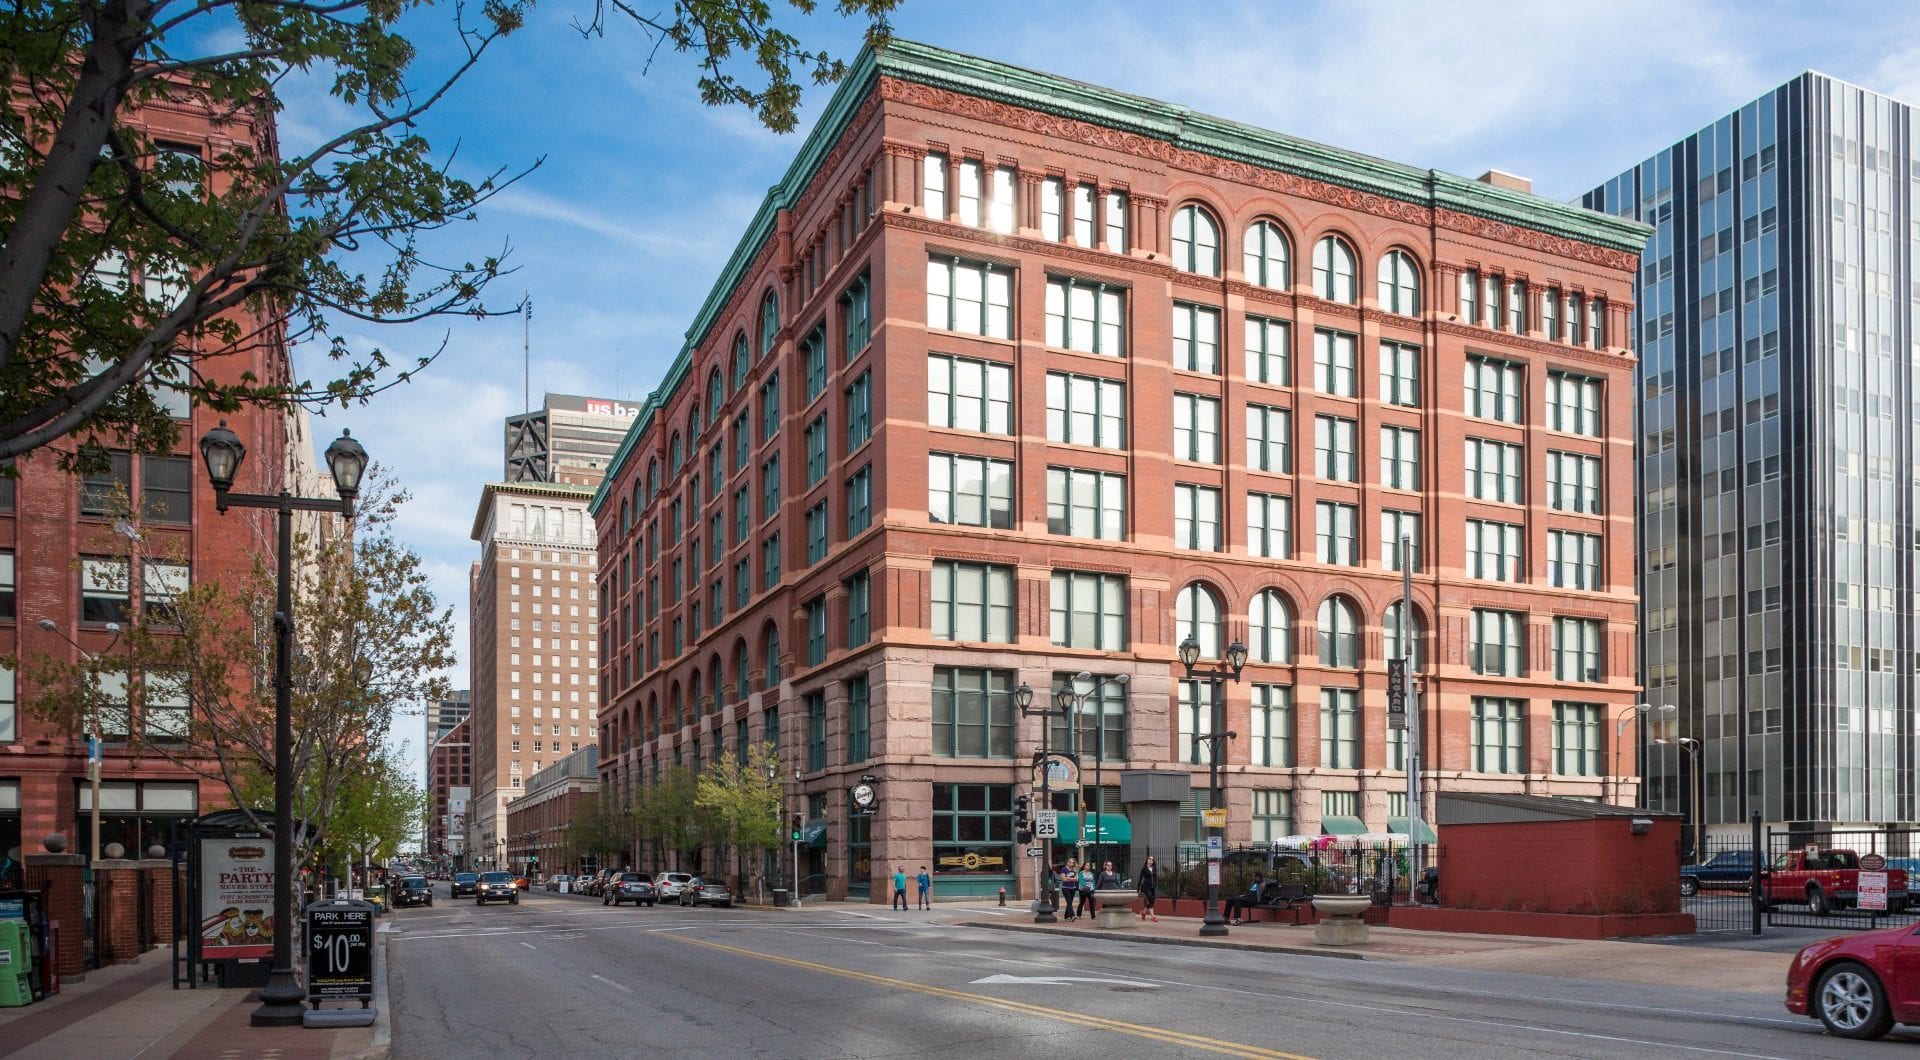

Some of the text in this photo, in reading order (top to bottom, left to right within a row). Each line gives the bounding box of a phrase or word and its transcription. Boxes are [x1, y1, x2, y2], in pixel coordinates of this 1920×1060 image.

[1039, 824, 1055, 834] 25
[219, 872, 275, 884] PARTY
[314, 912, 367, 920] PARK HERE
